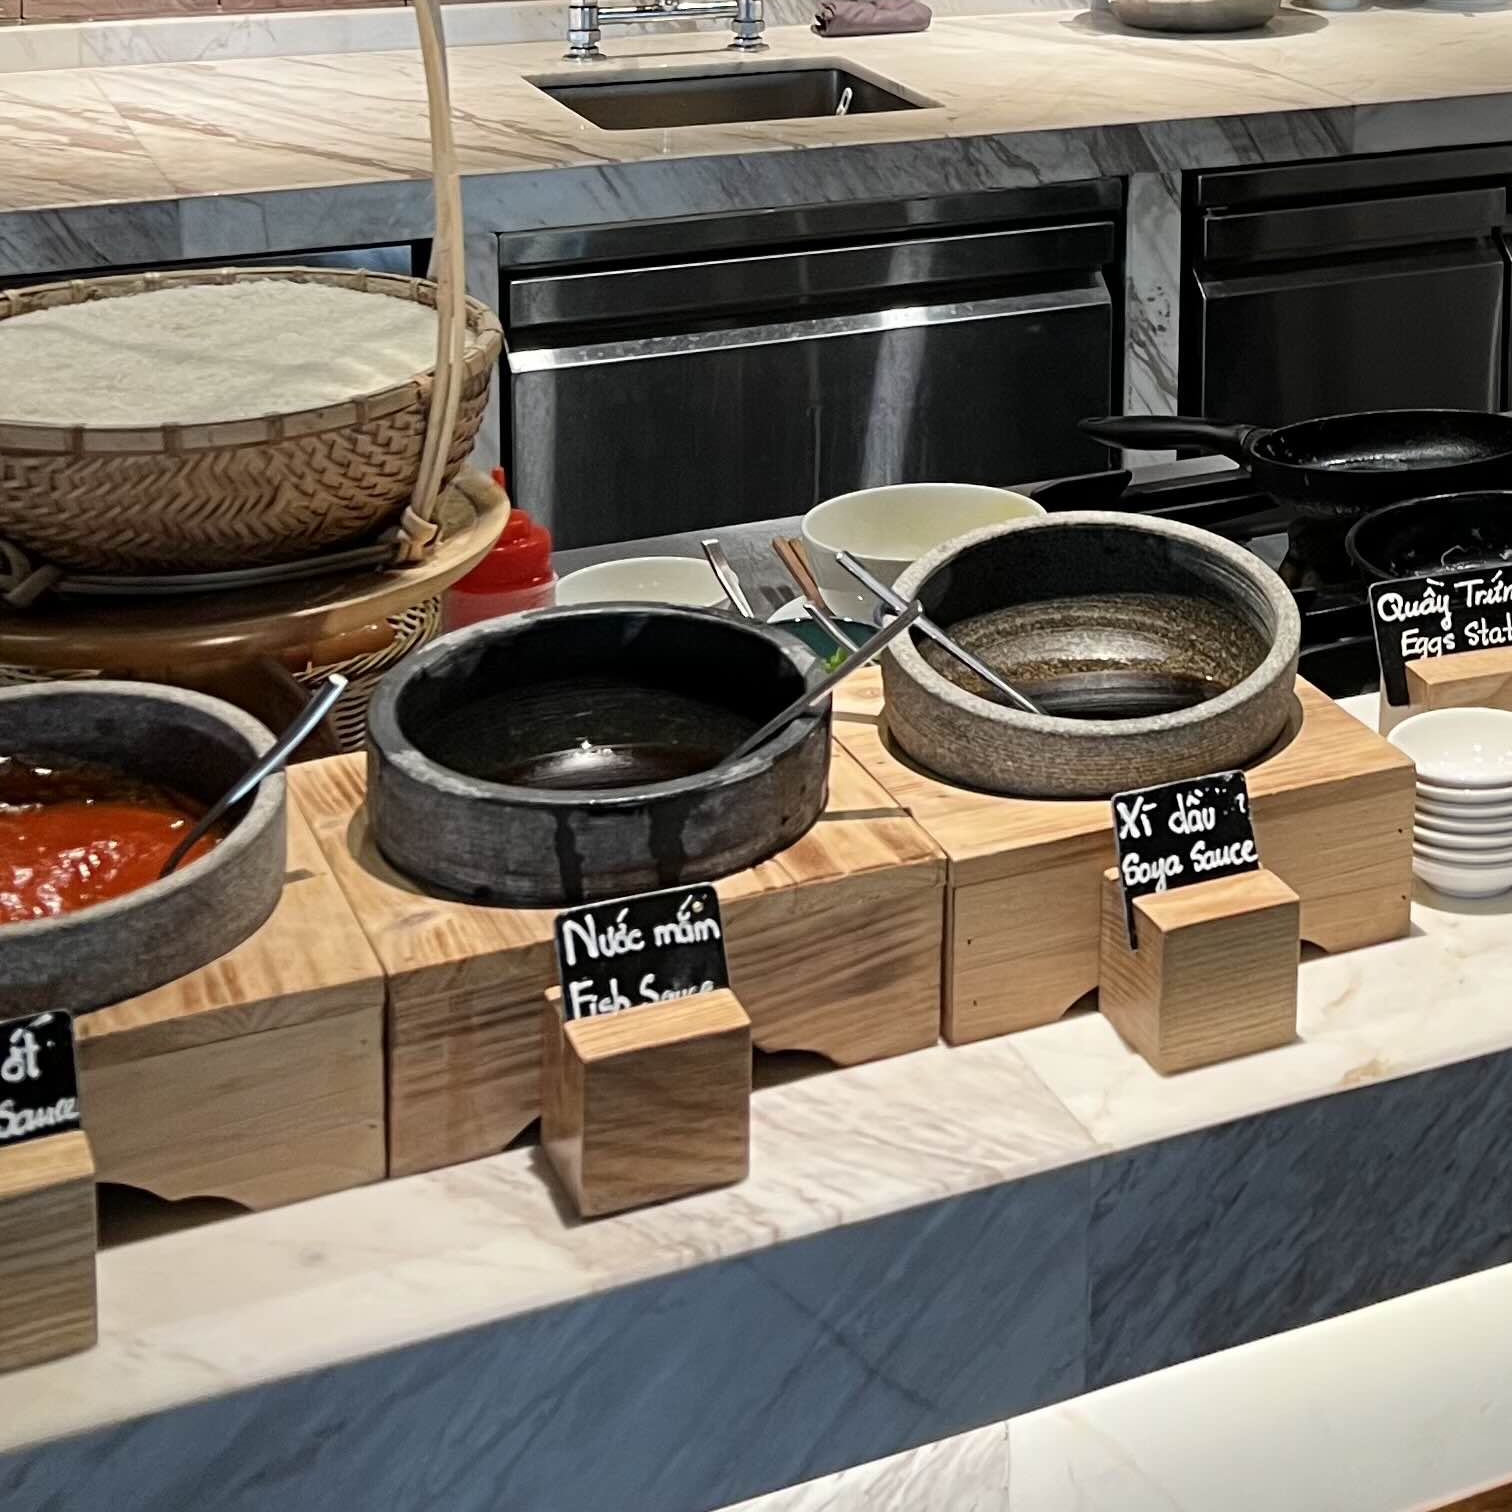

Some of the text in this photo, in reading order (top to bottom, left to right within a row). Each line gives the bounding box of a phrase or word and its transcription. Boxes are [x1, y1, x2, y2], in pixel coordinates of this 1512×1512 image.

[1377, 578, 1452, 631] Quầy
[1401, 628, 1455, 658] Eggs
[1190, 840, 1259, 872] Sauce
[562, 895, 721, 966] Nước mắm
[569, 978, 632, 1018] Fish
